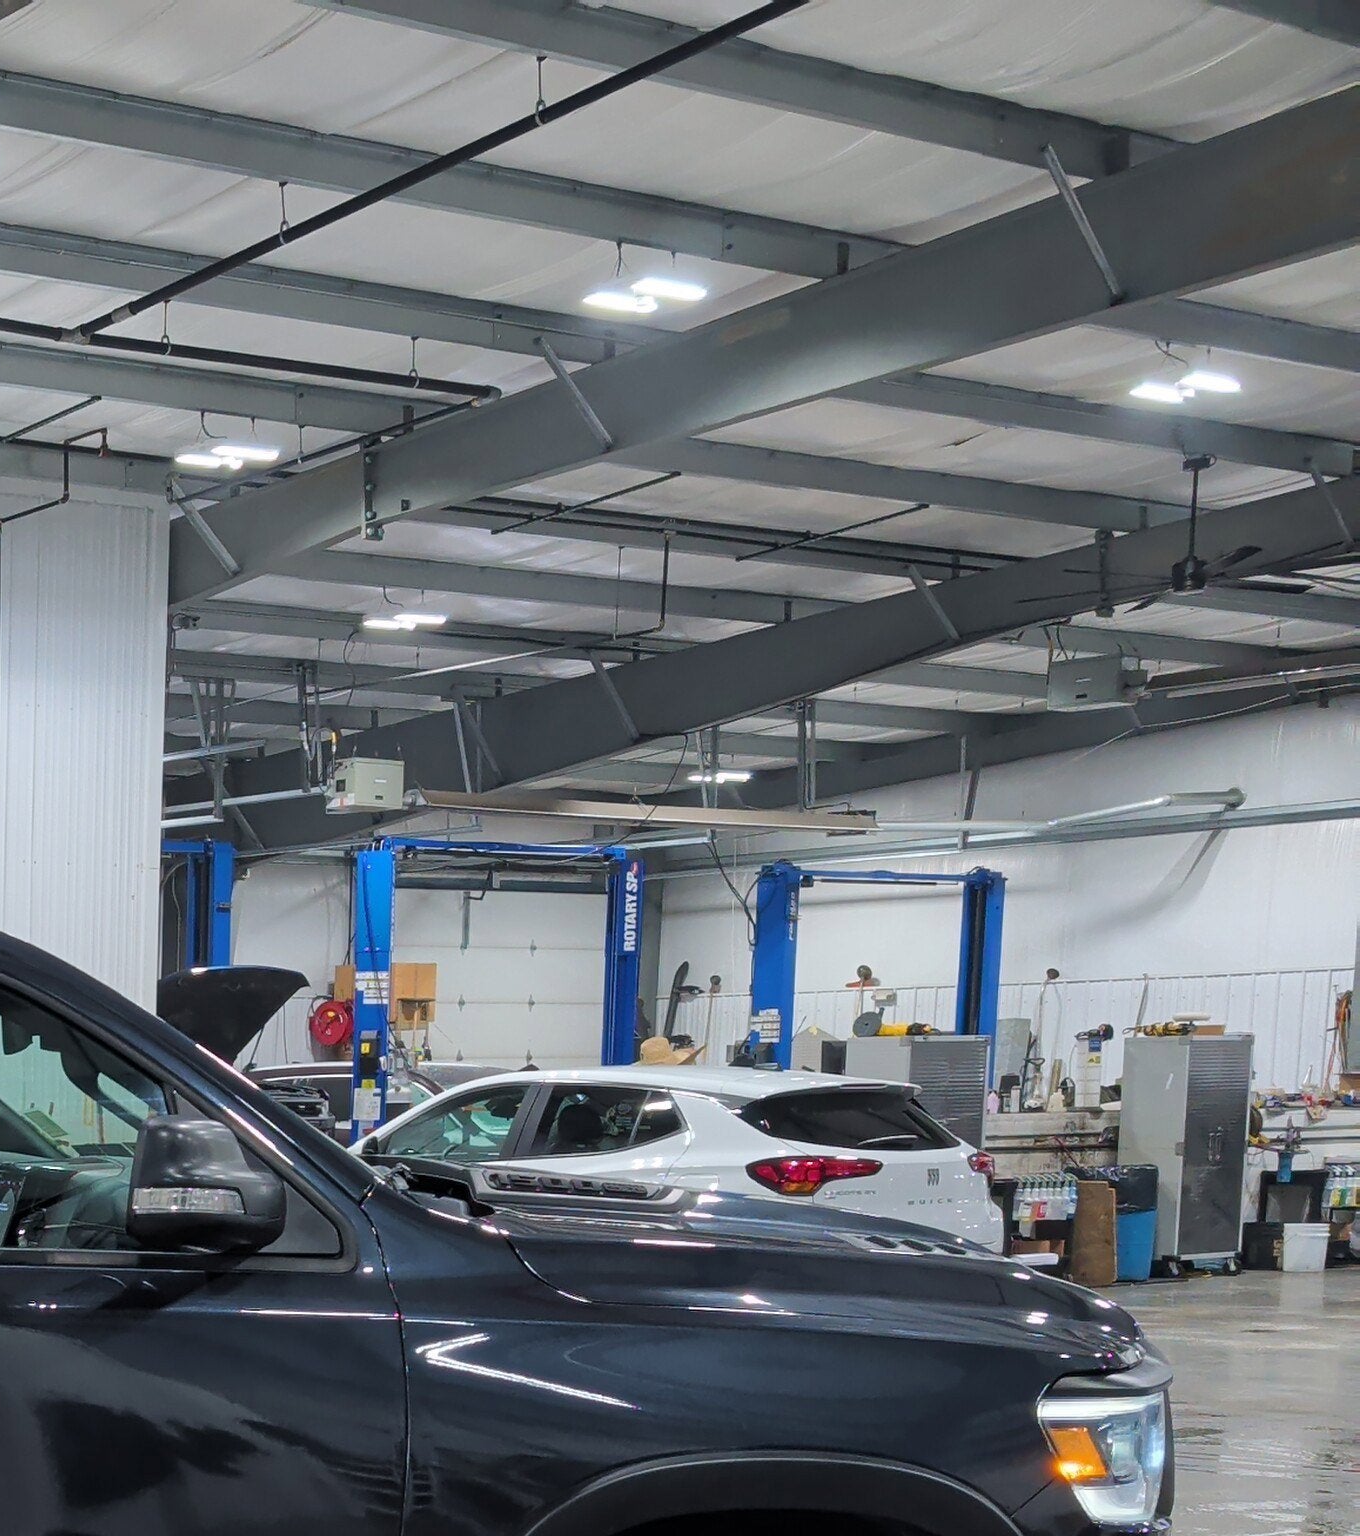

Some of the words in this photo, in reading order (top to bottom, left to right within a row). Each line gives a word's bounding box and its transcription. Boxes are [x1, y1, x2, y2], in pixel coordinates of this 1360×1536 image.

[626, 871, 639, 892] SP
[623, 892, 638, 952] ROTARY
[907, 1198, 953, 1206] BUICK
